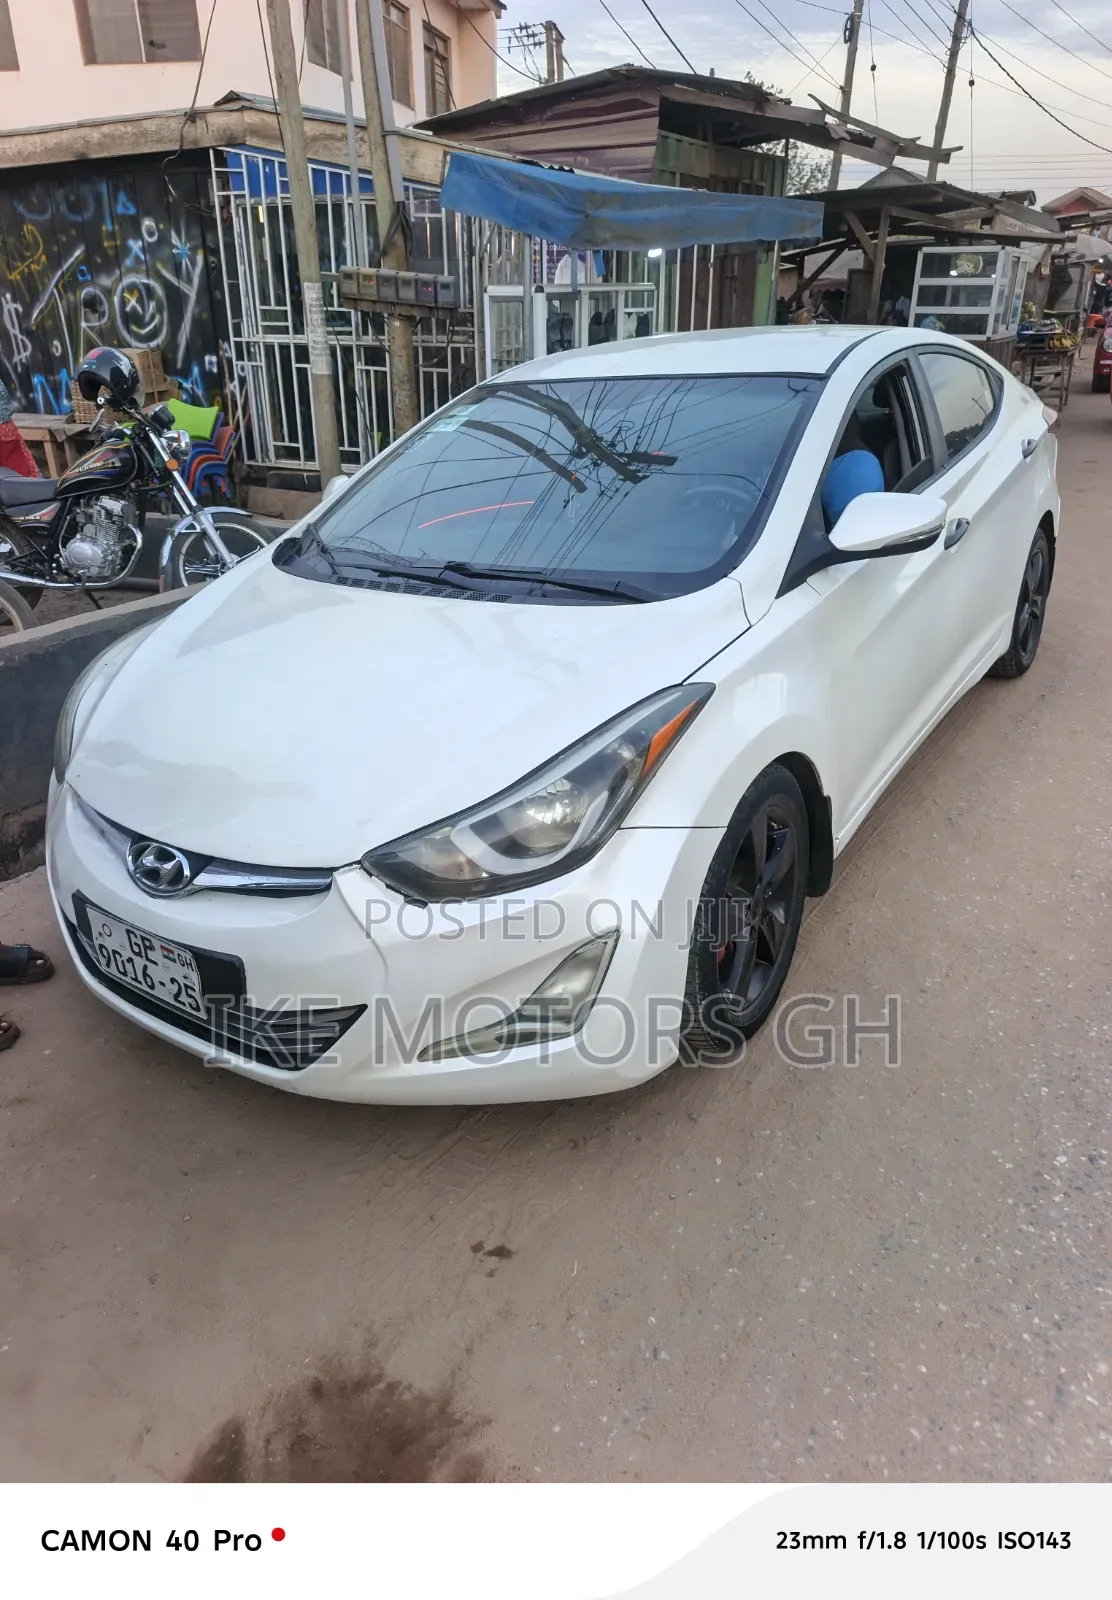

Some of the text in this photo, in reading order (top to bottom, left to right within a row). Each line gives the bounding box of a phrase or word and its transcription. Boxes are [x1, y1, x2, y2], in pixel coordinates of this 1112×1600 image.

[97, 943, 202, 1014] 9016-25
[125, 927, 195, 973] GE GH
